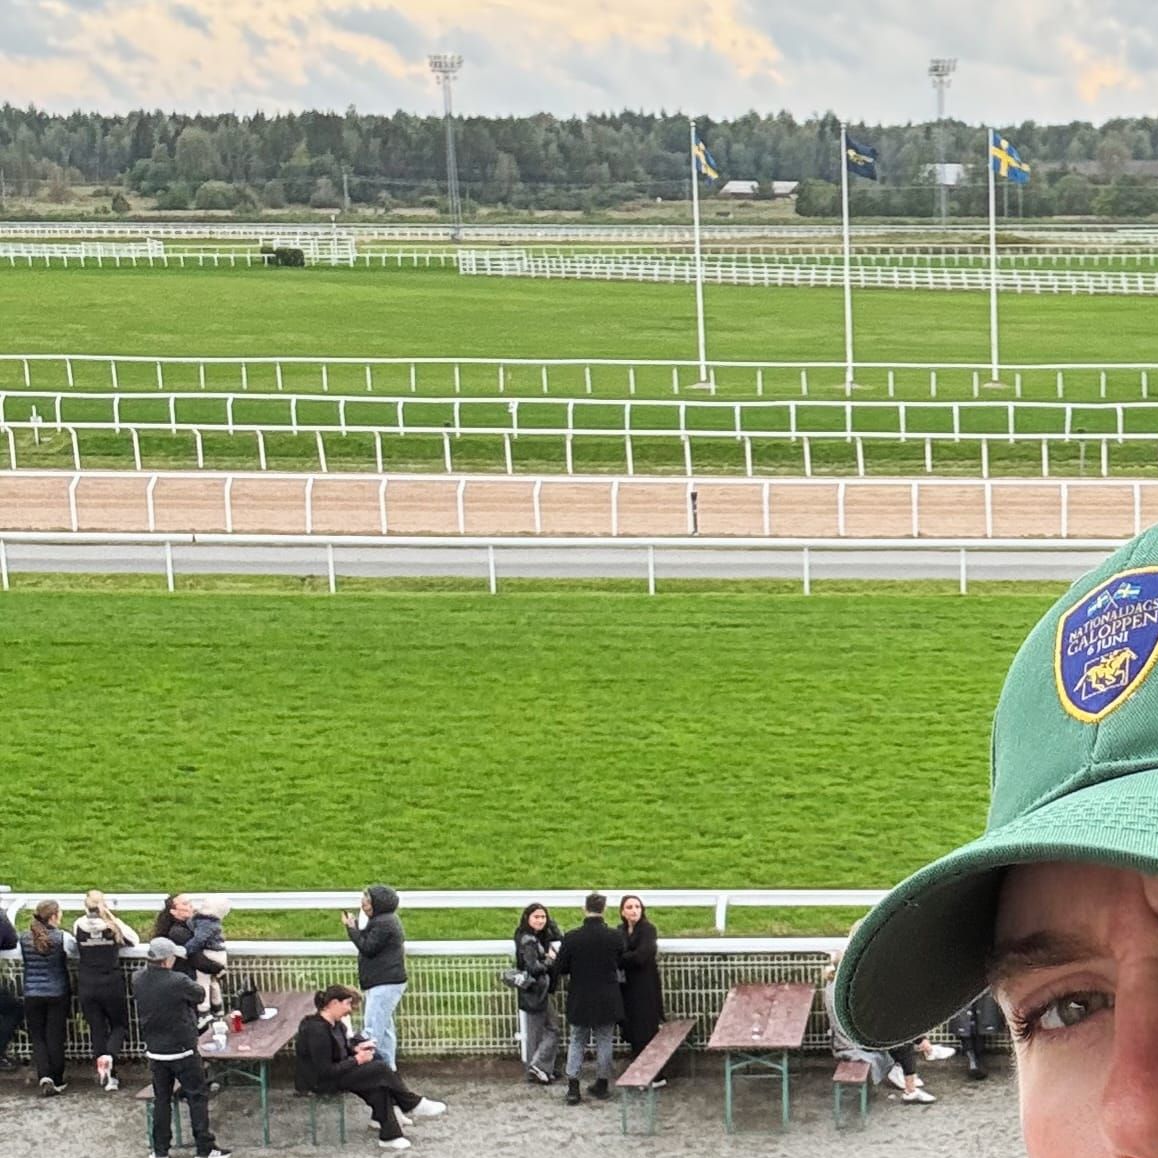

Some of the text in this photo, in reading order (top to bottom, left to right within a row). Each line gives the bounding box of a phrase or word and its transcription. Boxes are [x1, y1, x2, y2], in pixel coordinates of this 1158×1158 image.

[1067, 610, 1158, 656] GALOPPEN
[1087, 631, 1129, 655] 6 JUNI
